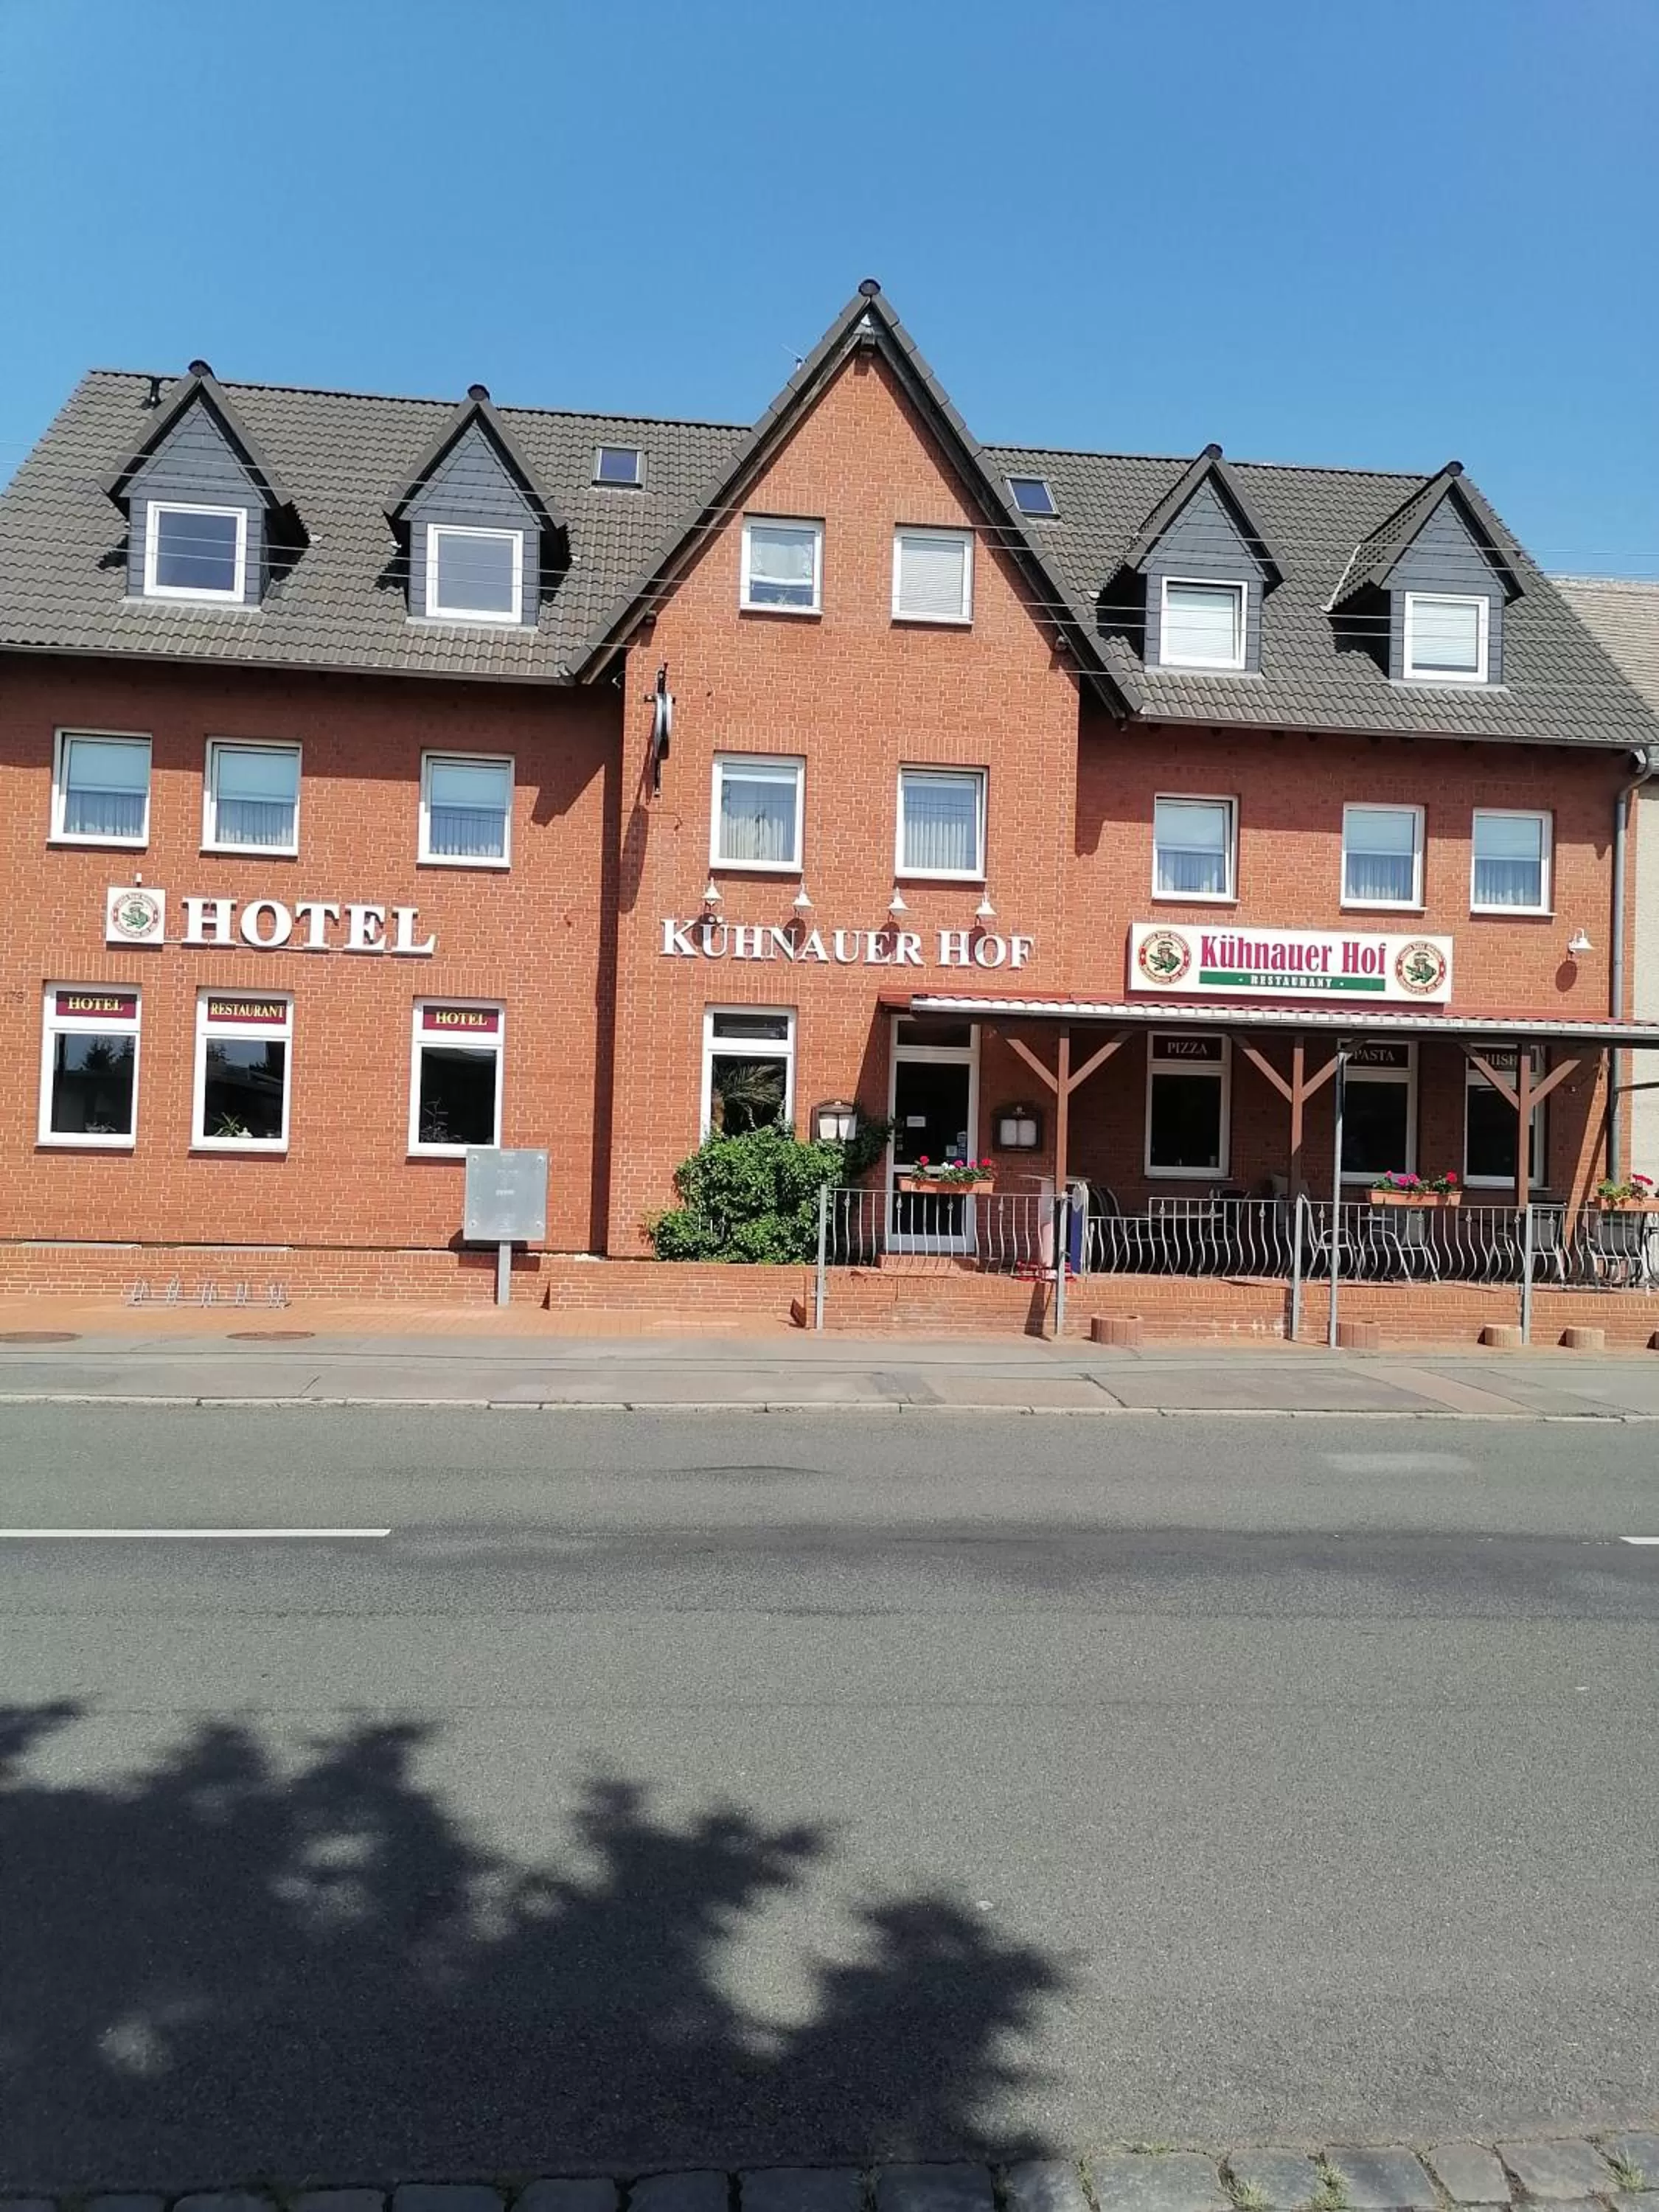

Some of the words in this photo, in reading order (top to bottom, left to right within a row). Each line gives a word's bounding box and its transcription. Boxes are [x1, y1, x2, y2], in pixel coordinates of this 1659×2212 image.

[182, 897, 436, 953] HOTEL
[661, 916, 923, 964] KÜHNAUER
[937, 930, 1033, 967] HOF
[1200, 934, 1333, 973] Kühnauer
[1341, 942, 1387, 975] Hof
[1251, 975, 1333, 988] RESTAURANT
[68, 997, 123, 1012] HOTEL
[210, 1003, 285, 1018] RESTAURANT
[435, 1012, 487, 1026] HOTEL
[1166, 1040, 1207, 1056] PIZZA
[1354, 1048, 1395, 1062] PASTA
